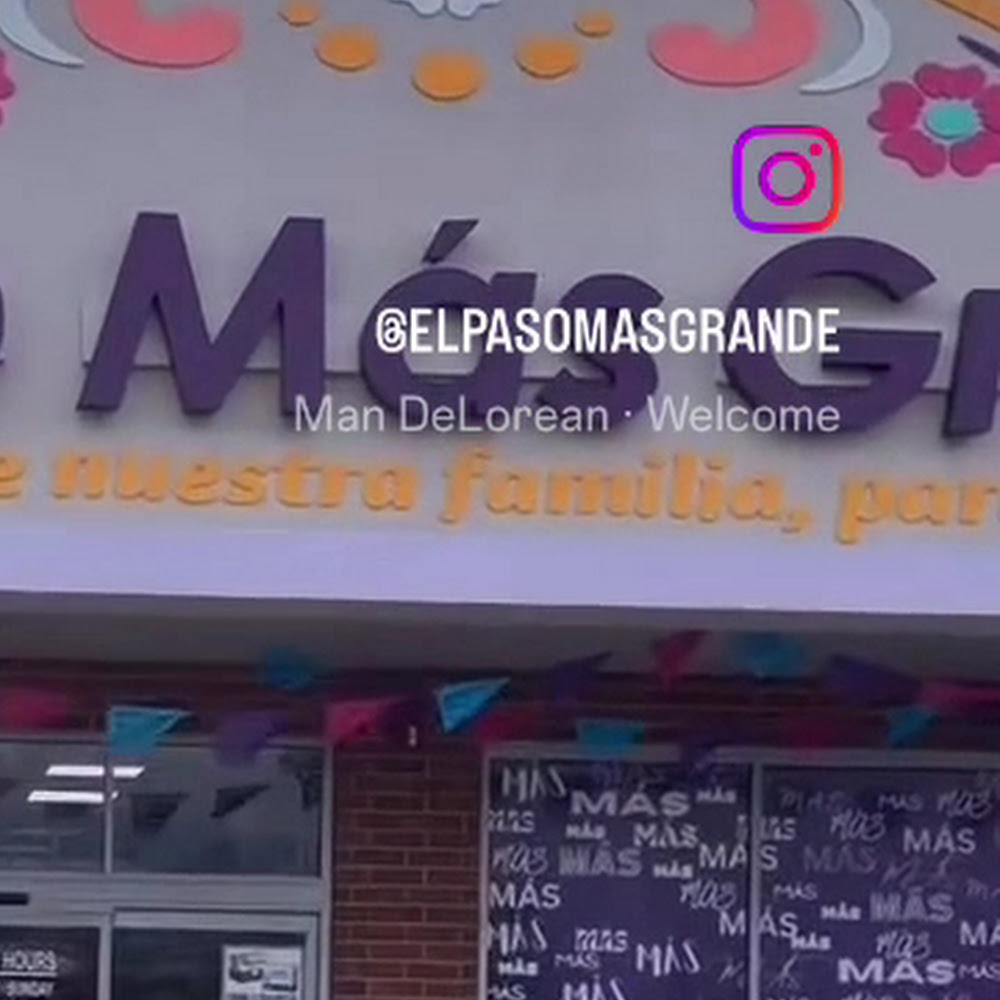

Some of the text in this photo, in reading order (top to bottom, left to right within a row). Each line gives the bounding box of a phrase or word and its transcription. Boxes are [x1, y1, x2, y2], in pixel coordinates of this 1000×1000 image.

[75, 210, 664, 437] Más
[52, 448, 416, 512] nuestra
[438, 448, 812, 533] familia,
